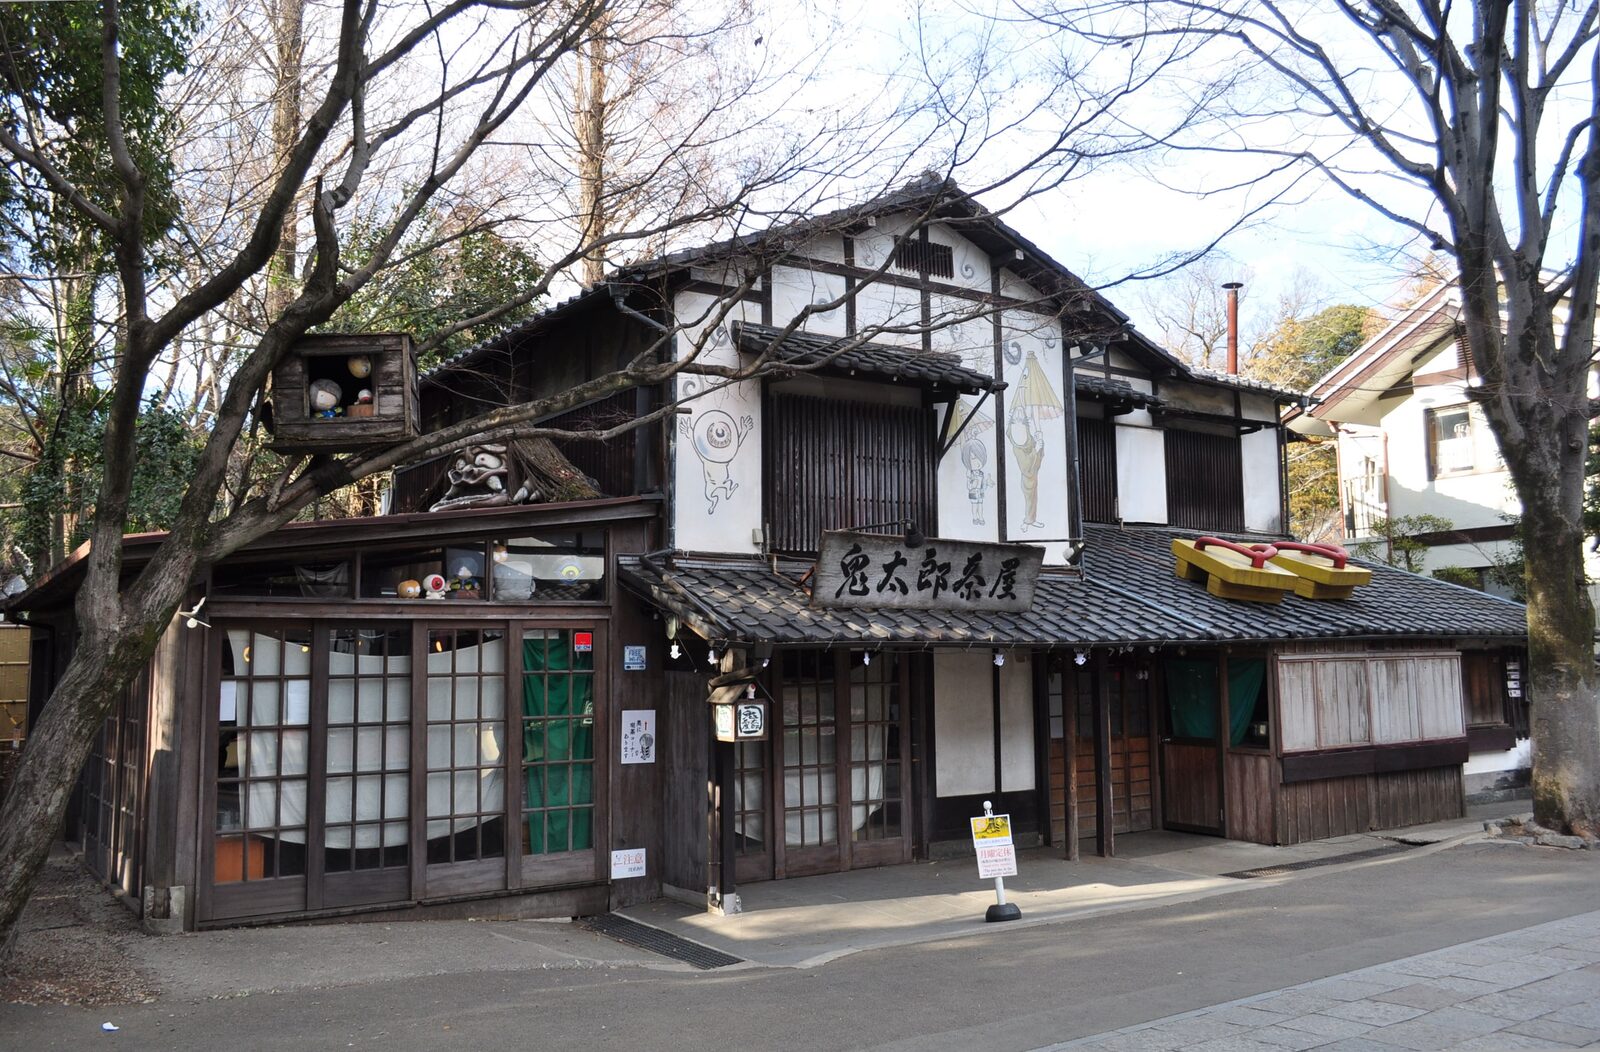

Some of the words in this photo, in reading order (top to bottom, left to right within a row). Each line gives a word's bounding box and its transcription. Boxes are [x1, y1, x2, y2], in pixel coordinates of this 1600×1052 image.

[834, 543, 1021, 601] 鬼太郎茶屋
[623, 852, 644, 865] 注意
